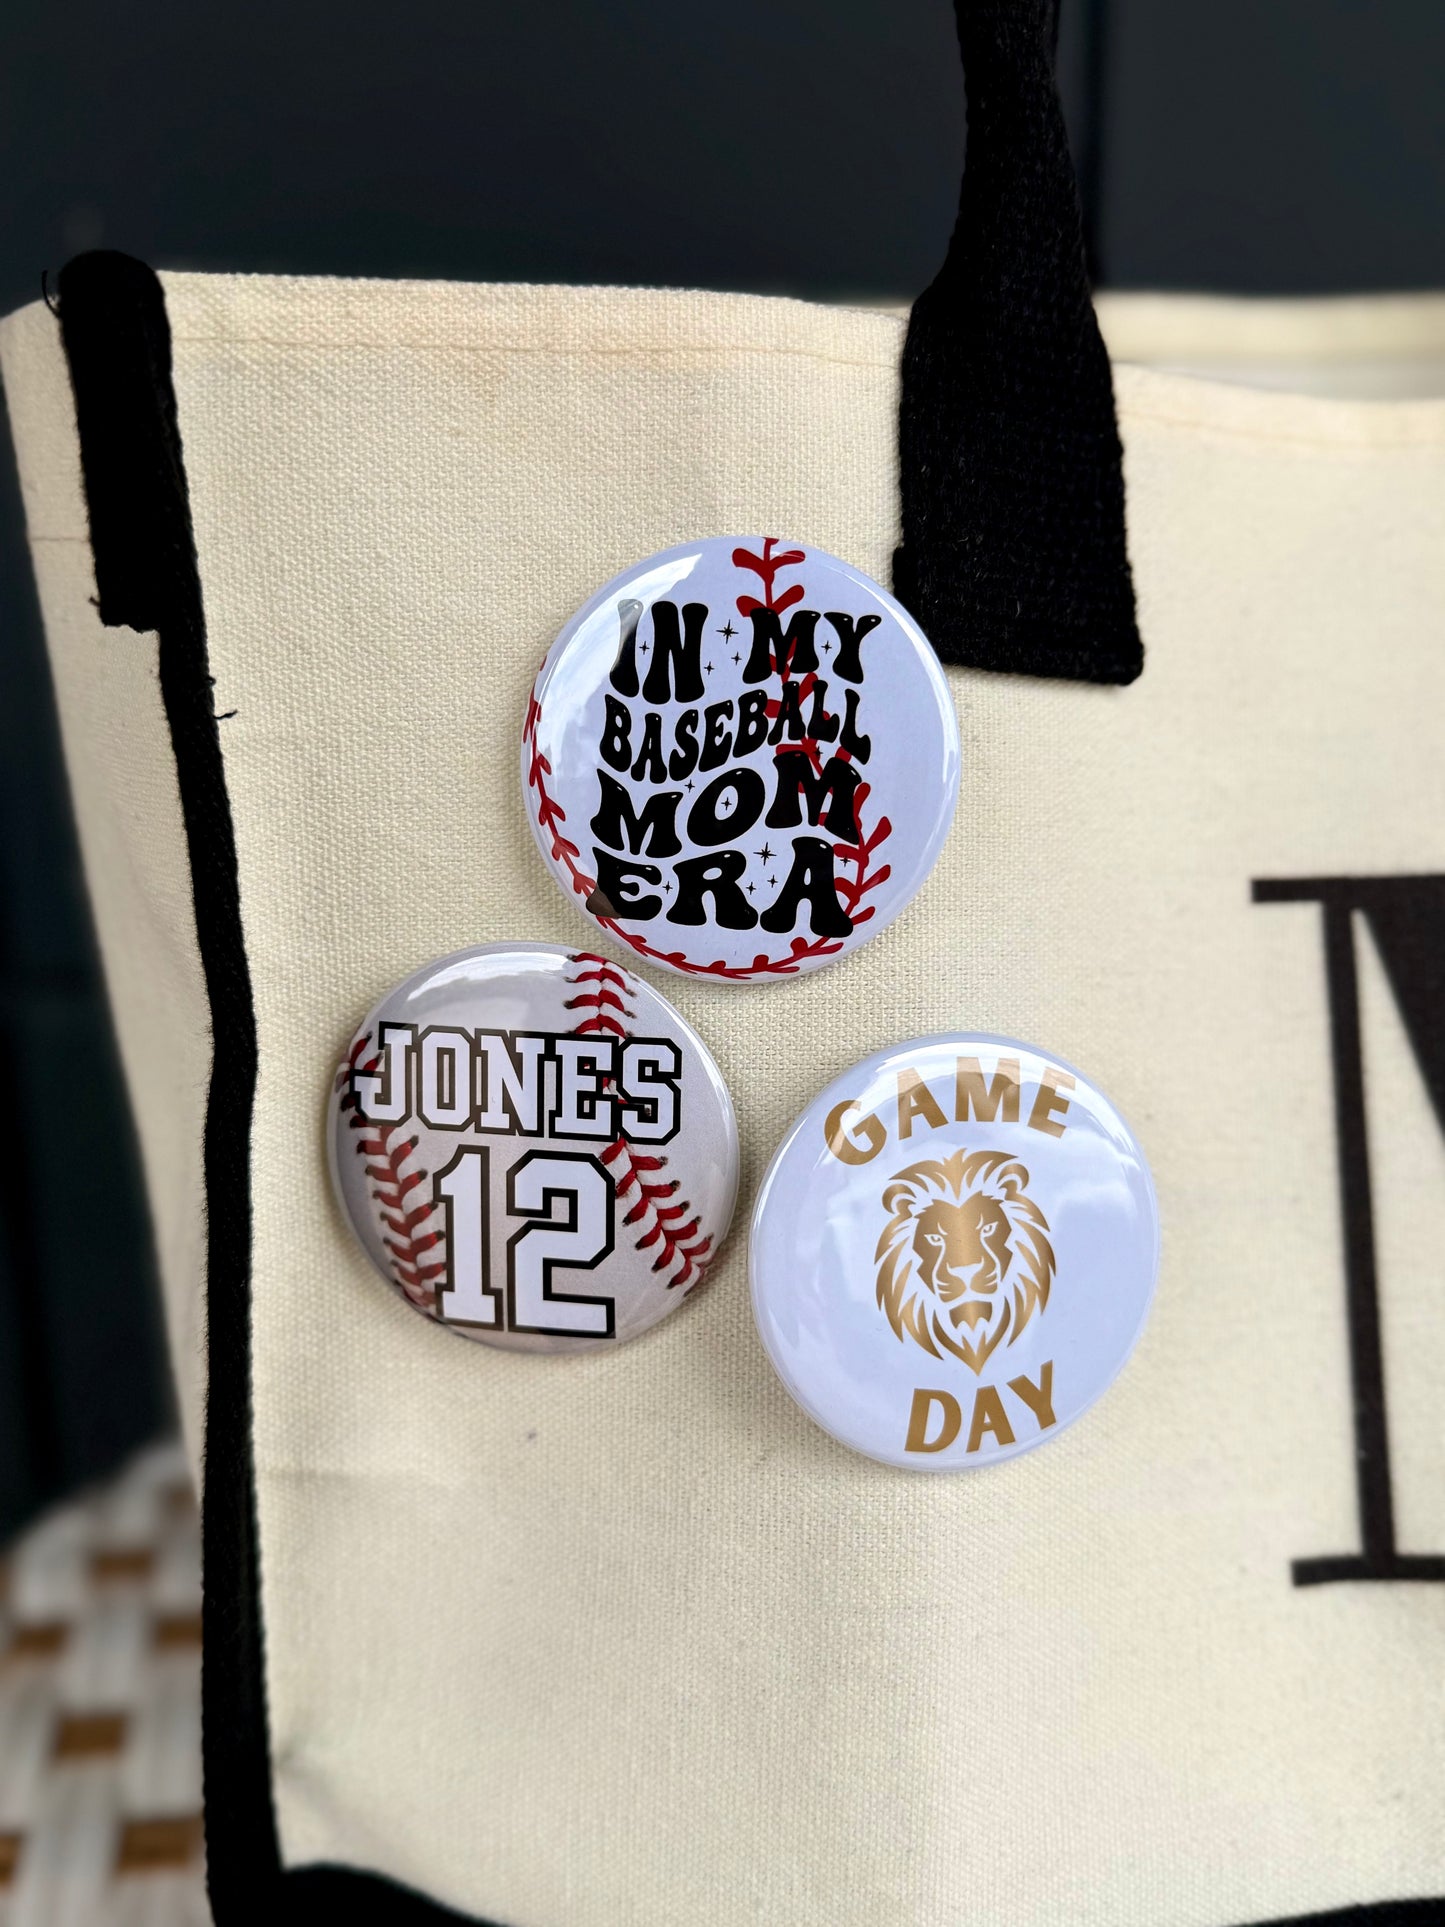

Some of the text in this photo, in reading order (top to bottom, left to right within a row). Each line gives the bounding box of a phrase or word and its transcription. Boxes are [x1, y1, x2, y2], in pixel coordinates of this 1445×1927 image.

[609, 598, 881, 704] IN MY
[600, 680, 871, 783] BASEBALL
[590, 750, 863, 858] MOM
[586, 836, 853, 937] ERA
[350, 1021, 682, 1145] JONES
[824, 1056, 1076, 1165] GAME
[433, 1144, 615, 1338] 12
[905, 1360, 1056, 1452] DAY
